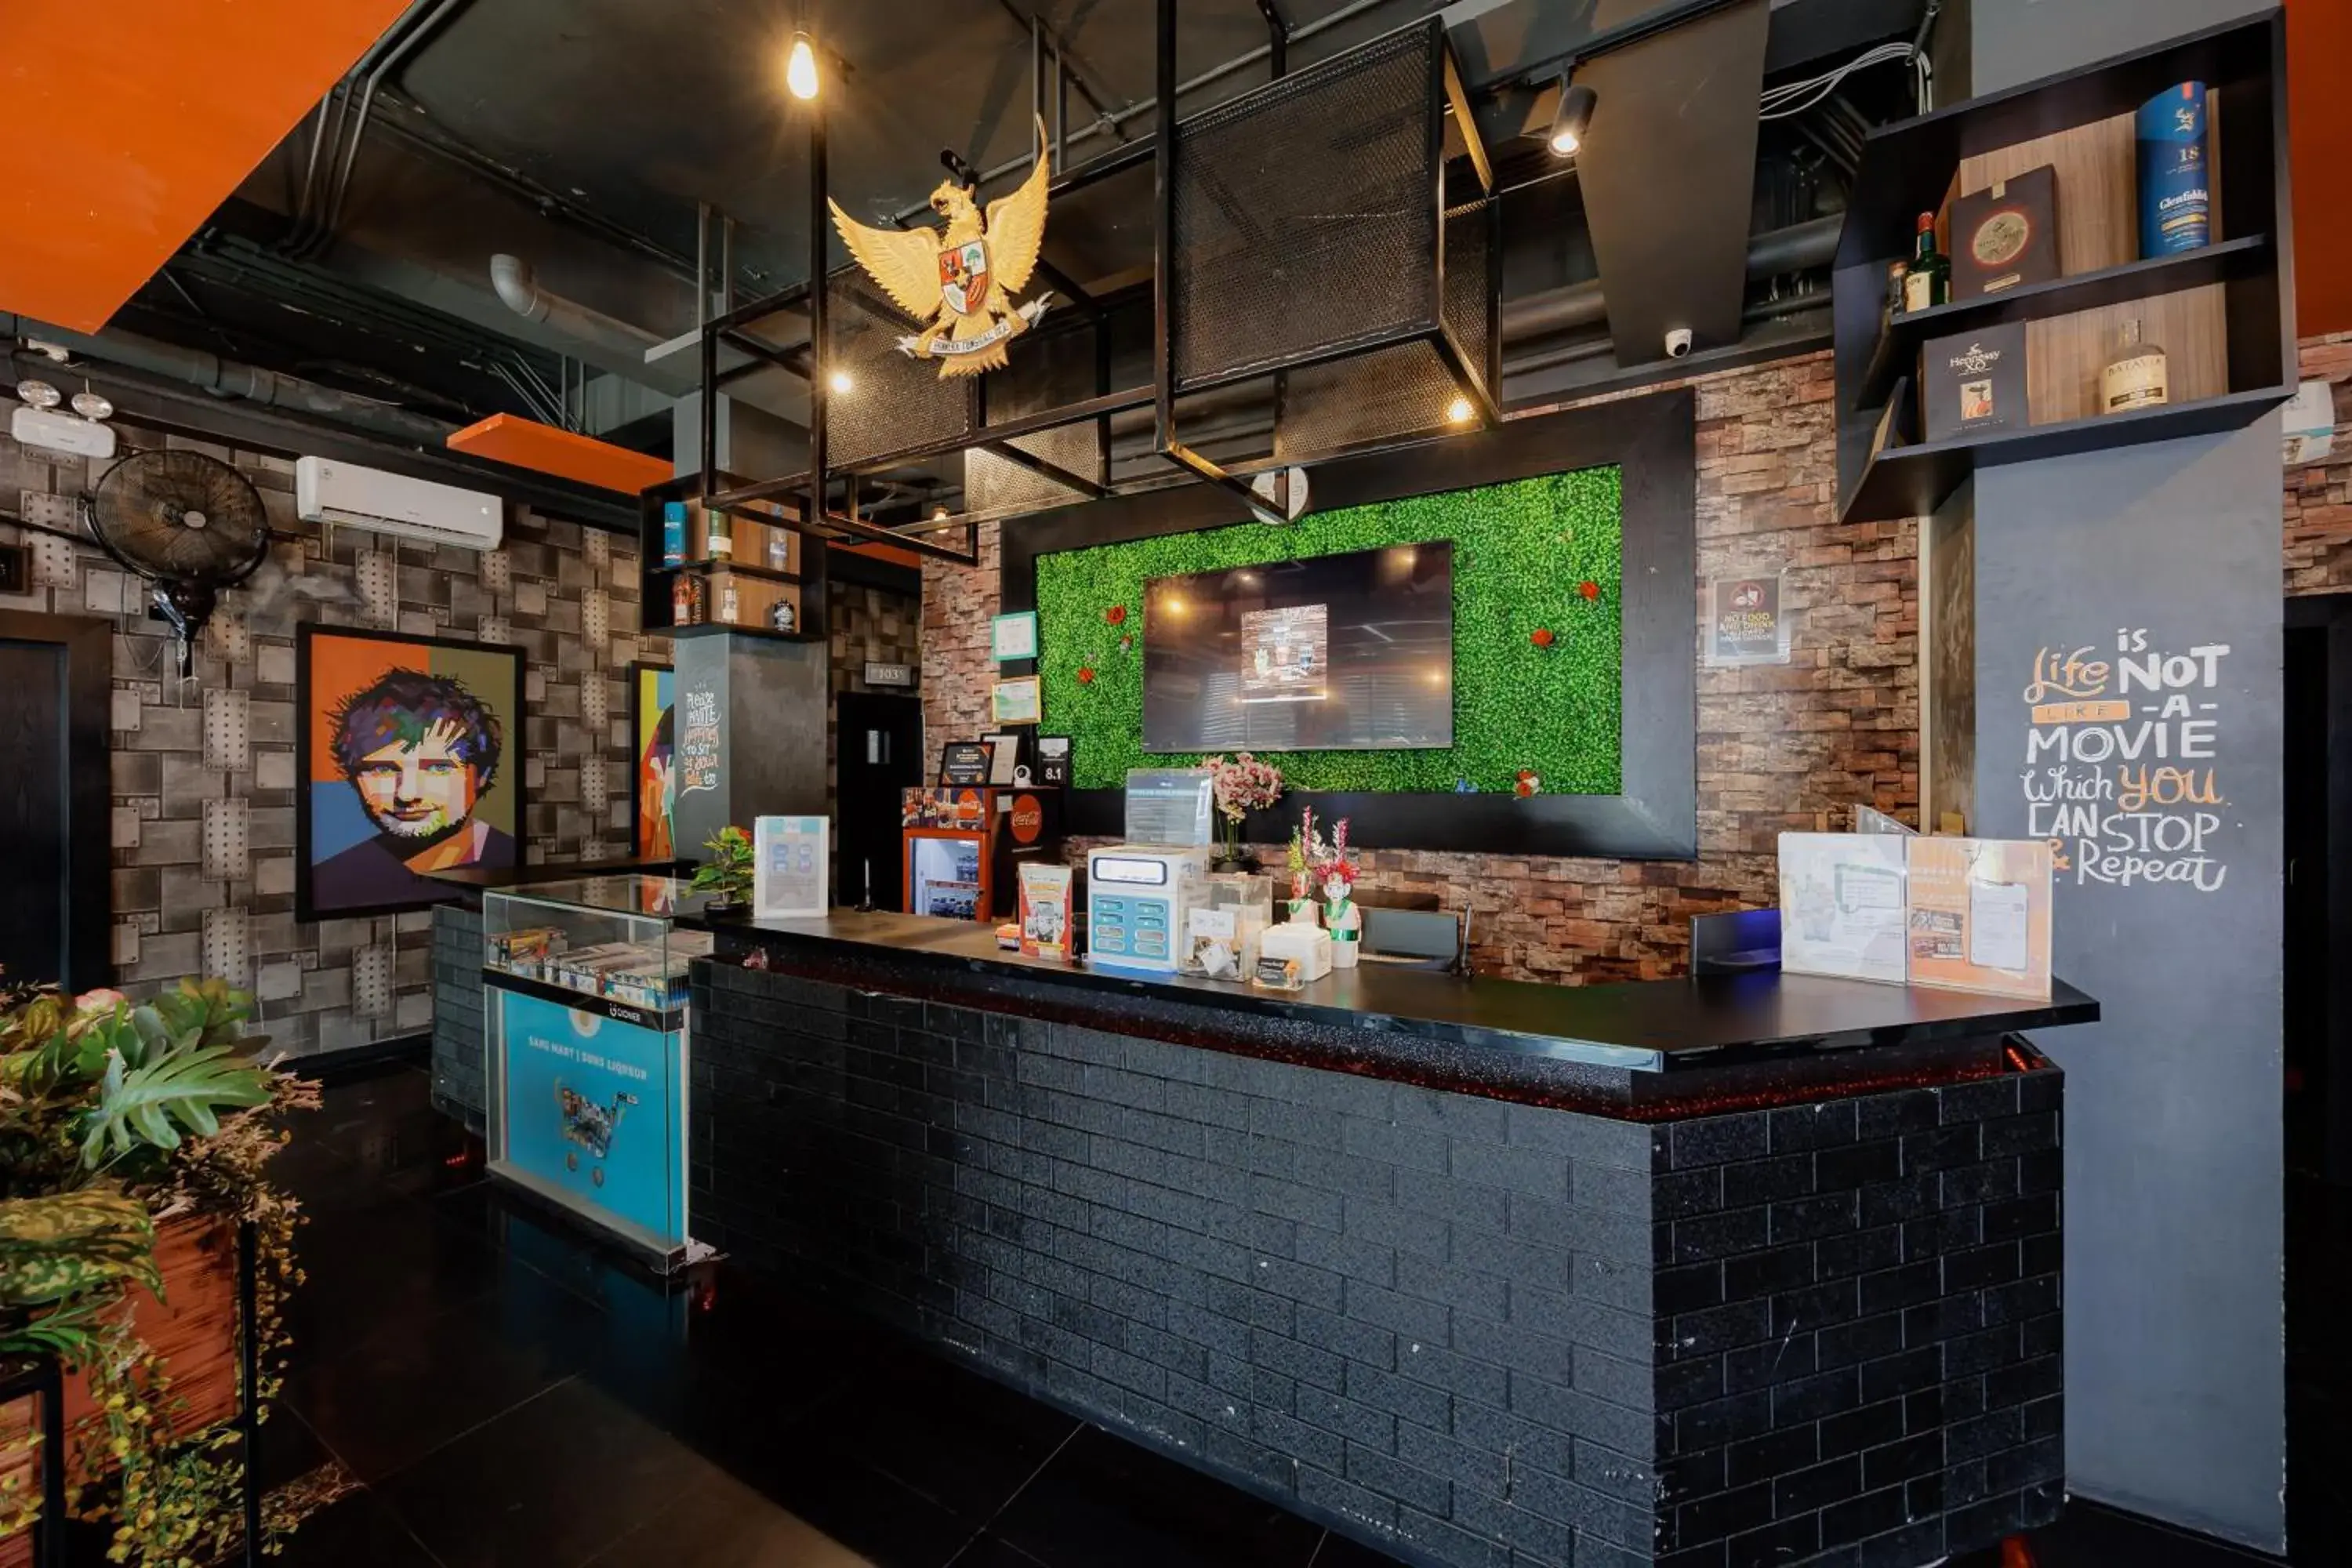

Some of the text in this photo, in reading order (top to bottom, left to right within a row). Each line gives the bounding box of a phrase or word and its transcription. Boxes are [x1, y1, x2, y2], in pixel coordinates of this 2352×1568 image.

[2024, 644, 2230, 703] Life NOT
[2027, 720, 2218, 764] MOVIE
[1045, 768, 1061, 780] 8.1
[2020, 764, 2114, 802] Which
[2029, 803, 2220, 852] CAN STOP
